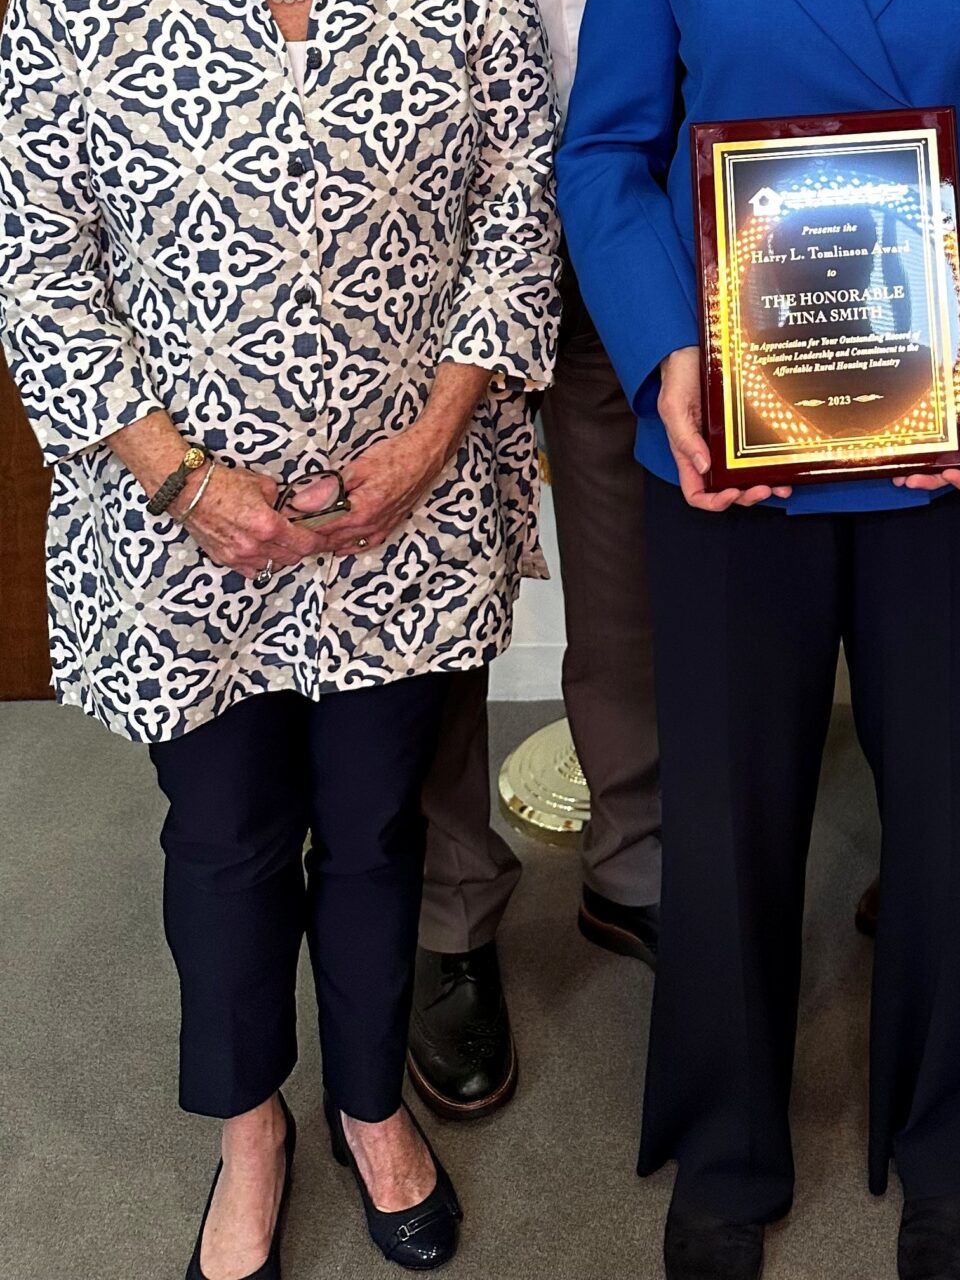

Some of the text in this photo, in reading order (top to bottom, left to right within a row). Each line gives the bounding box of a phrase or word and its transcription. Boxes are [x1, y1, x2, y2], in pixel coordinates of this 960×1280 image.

[802, 223, 857, 235] Presents the
[751, 240, 910, 264] Harry L. Tomlinson Award
[827, 269, 836, 277] to
[761, 285, 905, 308] THE HONORABLE
[788, 306, 882, 326] TINA SMITH
[750, 342, 759, 351] In
[760, 339, 807, 352] Appreciation
[807, 337, 820, 349] for
[821, 336, 838, 346] Your
[839, 333, 884, 343] Outstanding
[752, 343, 919, 365] Legislative Leadership and Commitment to the
[773, 358, 900, 377] Affordable Rural Housing Industry
[827, 395, 851, 406] 2023
